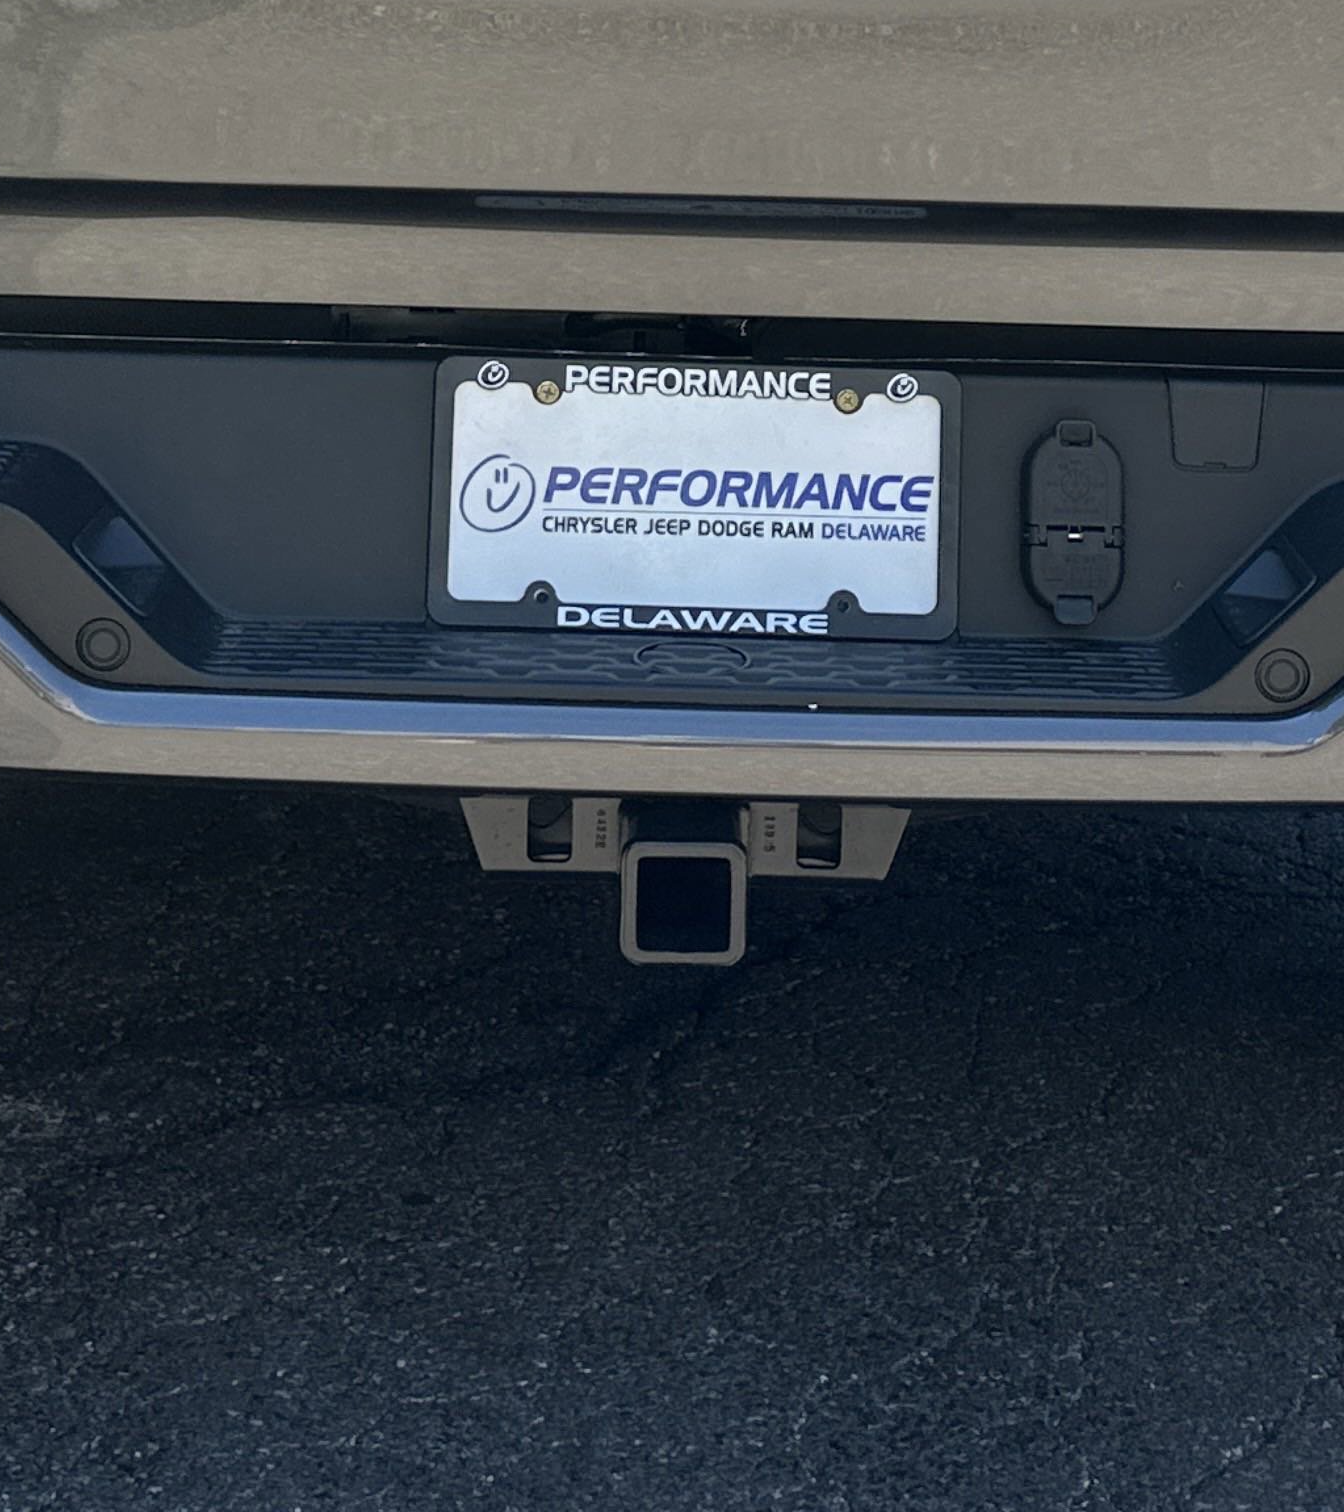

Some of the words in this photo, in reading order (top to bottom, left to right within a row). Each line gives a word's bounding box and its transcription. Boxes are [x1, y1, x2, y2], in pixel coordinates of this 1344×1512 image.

[565, 364, 831, 400] PERFORMANCE
[542, 466, 934, 513] PERFORMANCE
[542, 515, 637, 536] CHRYSLER
[643, 517, 691, 537] JEEP
[697, 519, 764, 539] DODGE
[771, 521, 814, 540] RAM
[821, 523, 926, 542] DELAWARE
[557, 605, 829, 634] DELAWARE
